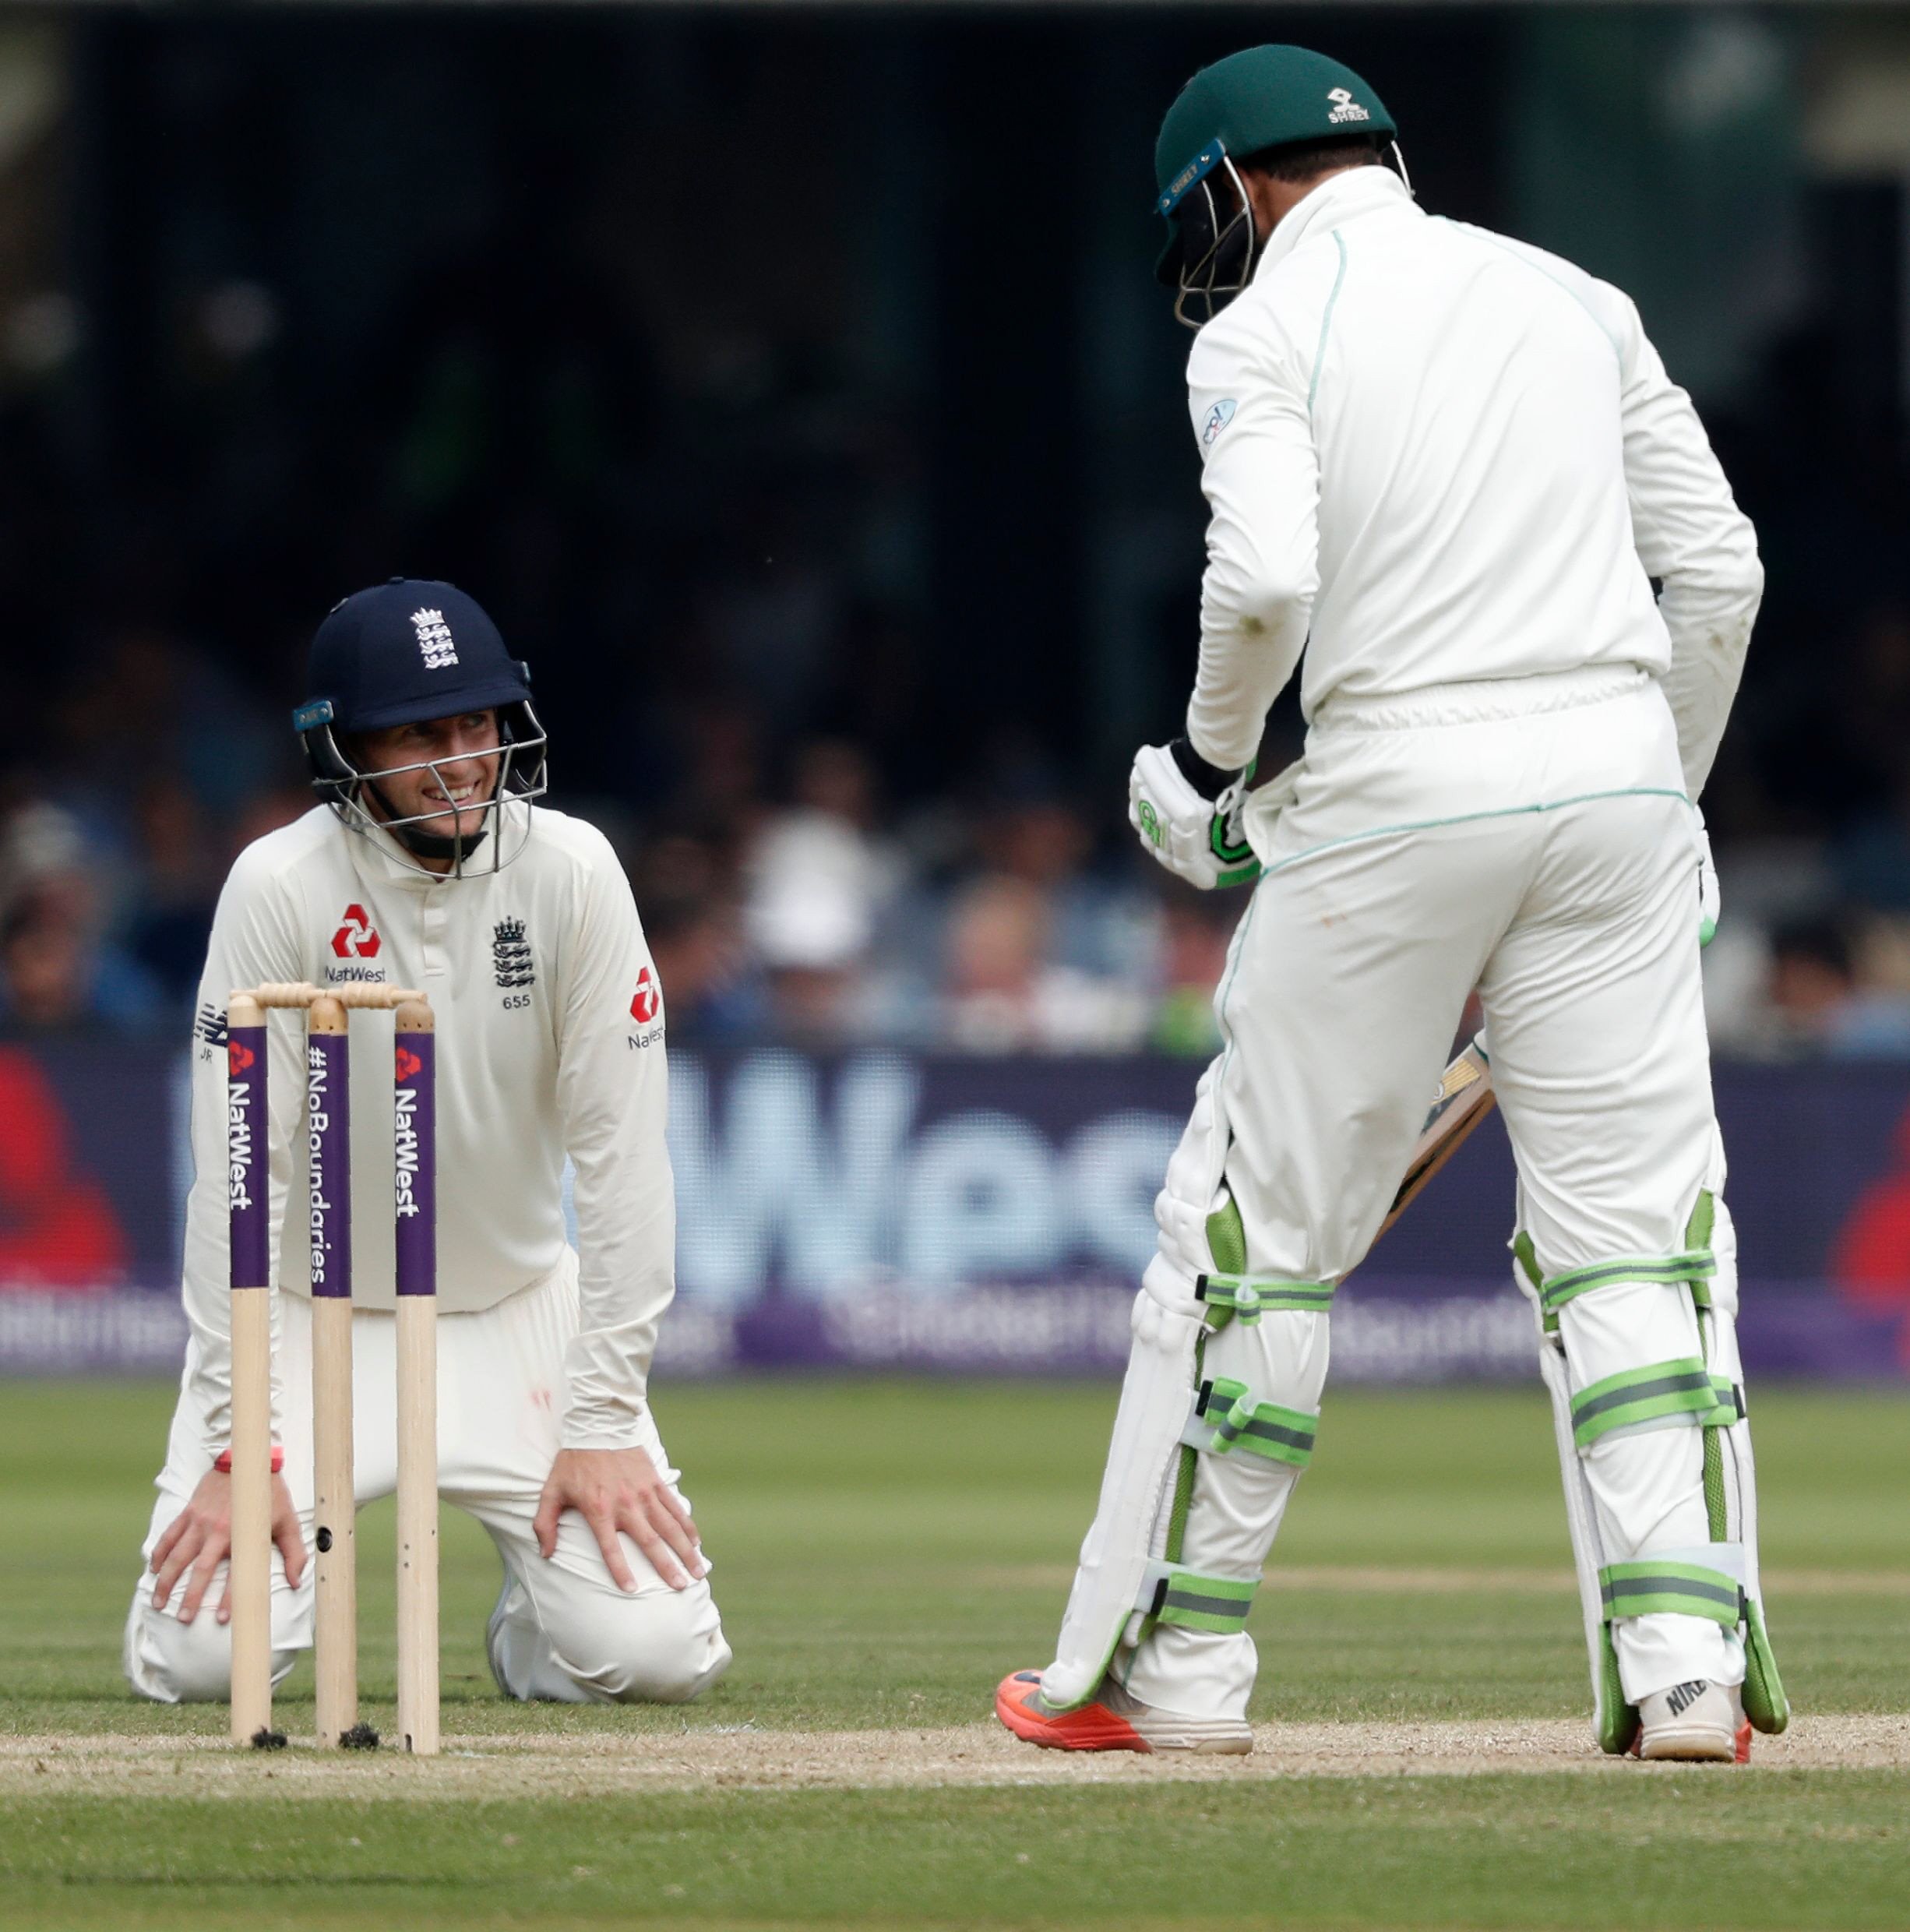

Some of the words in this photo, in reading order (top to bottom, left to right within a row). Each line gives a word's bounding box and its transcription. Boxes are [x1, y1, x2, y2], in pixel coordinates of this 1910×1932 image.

[1327, 108, 1370, 124] SHREY
[325, 965, 386, 982] NatWest
[502, 994, 531, 1010] 655
[200, 1046, 213, 1064] JR
[229, 1082, 252, 1211] NatWest
[395, 1088, 420, 1218] NatWest
[308, 1047, 332, 1284] #NoBoundaries
[1665, 1679, 1707, 1718] NIKE
